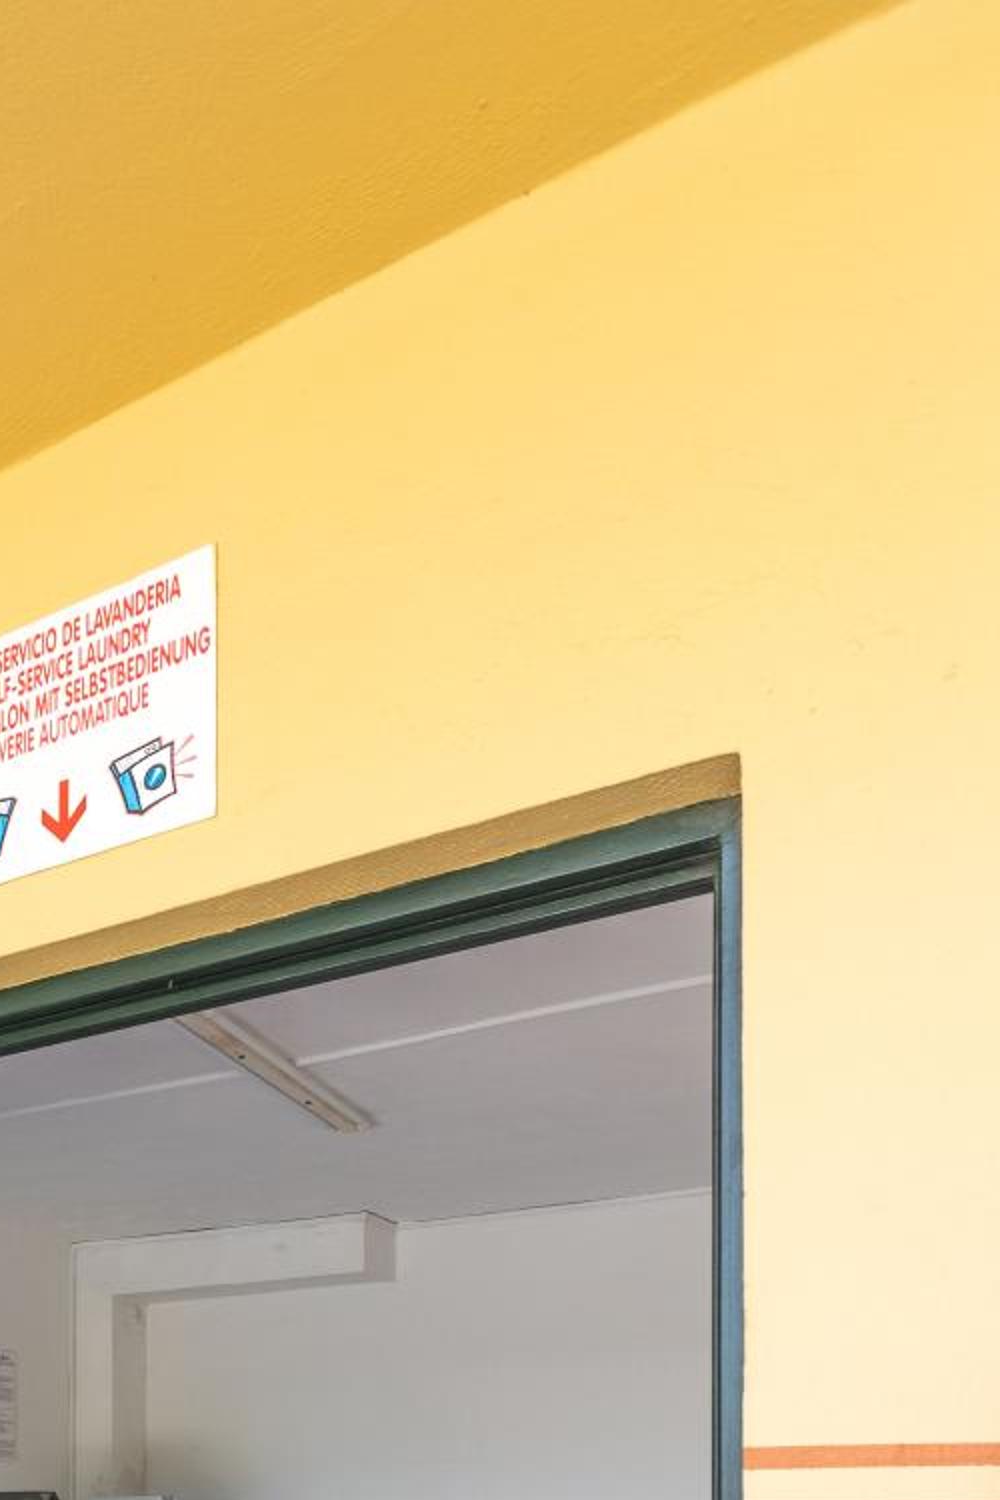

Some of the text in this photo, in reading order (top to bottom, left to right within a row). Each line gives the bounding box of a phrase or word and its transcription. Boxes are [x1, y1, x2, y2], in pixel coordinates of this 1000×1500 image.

[62, 618, 80, 647] DE
[86, 575, 181, 636] LAVANDERIA
[78, 619, 150, 669] LAUNDRY
[35, 688, 59, 719] MIT
[65, 627, 210, 706] SELBSTBEDIENUNG
[39, 683, 149, 747] AUTOMATIQUE
